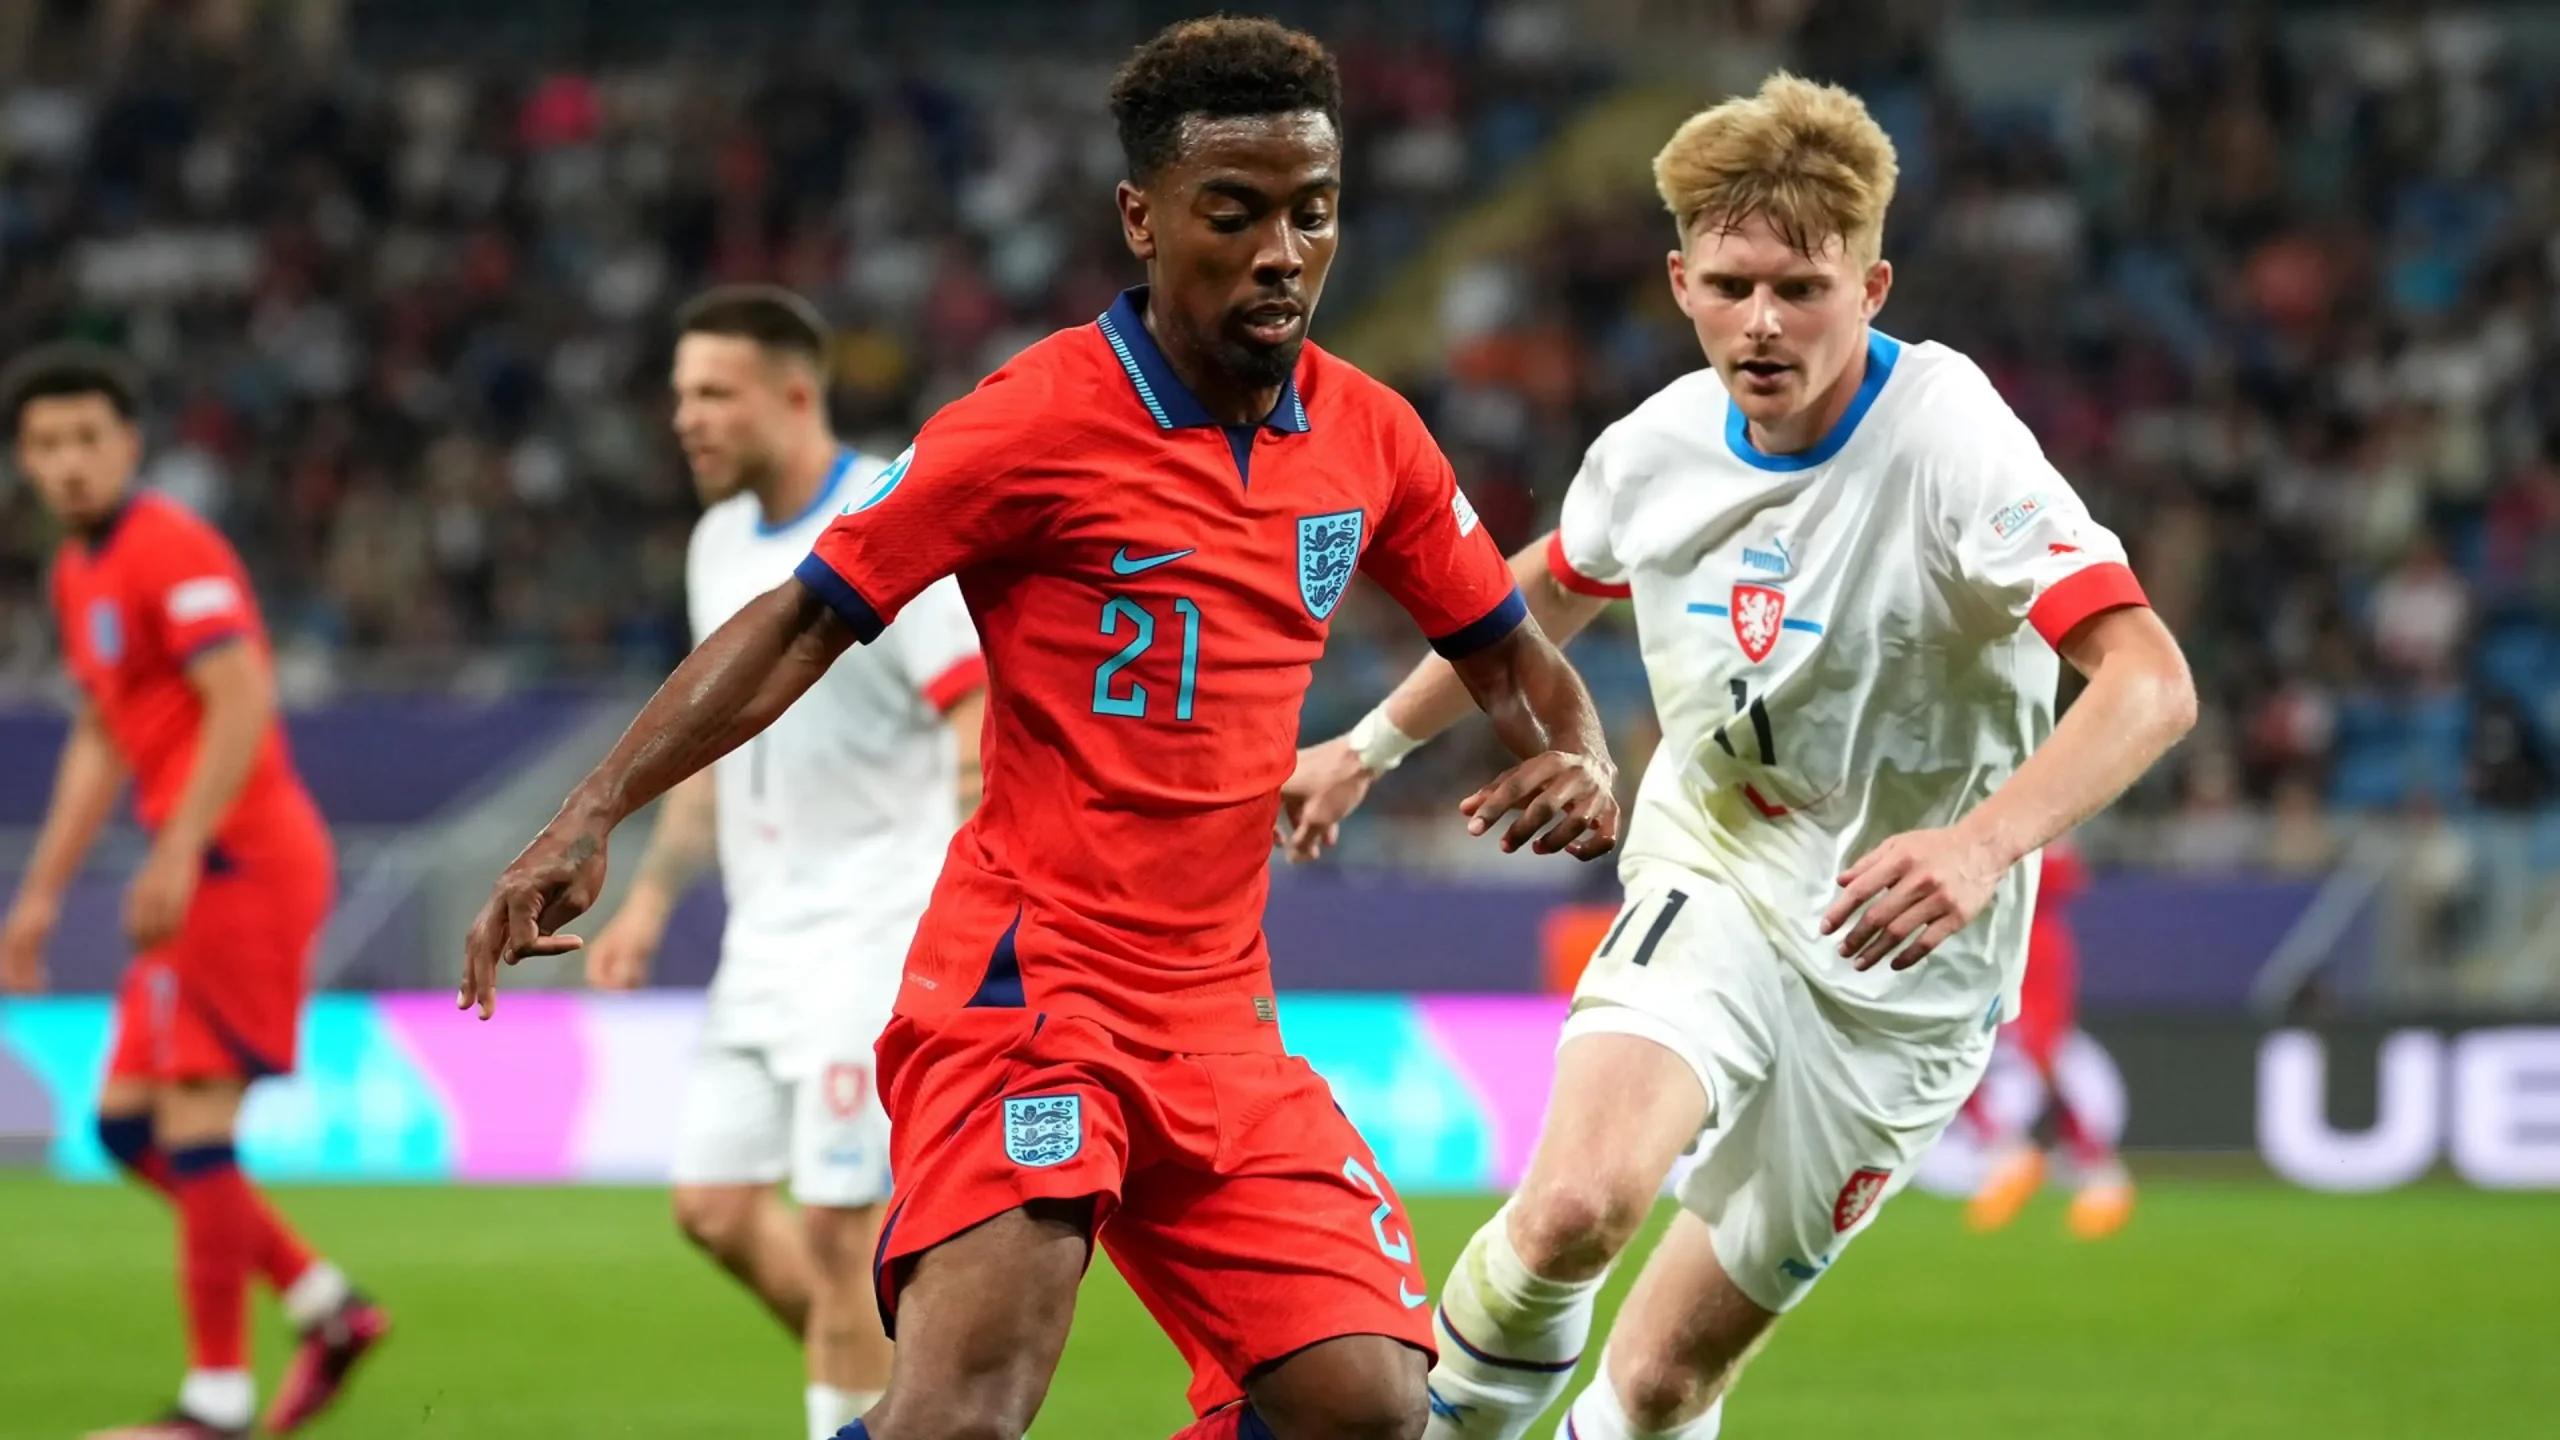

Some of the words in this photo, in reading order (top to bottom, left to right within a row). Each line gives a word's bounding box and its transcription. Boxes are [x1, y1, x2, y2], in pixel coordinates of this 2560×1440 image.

[1092, 595, 1201, 721] 21
[1713, 678, 1777, 766] 11
[1598, 888, 1690, 967] 11
[2256, 1025, 2560, 1192] UE
[1342, 1155, 1412, 1264] 2
